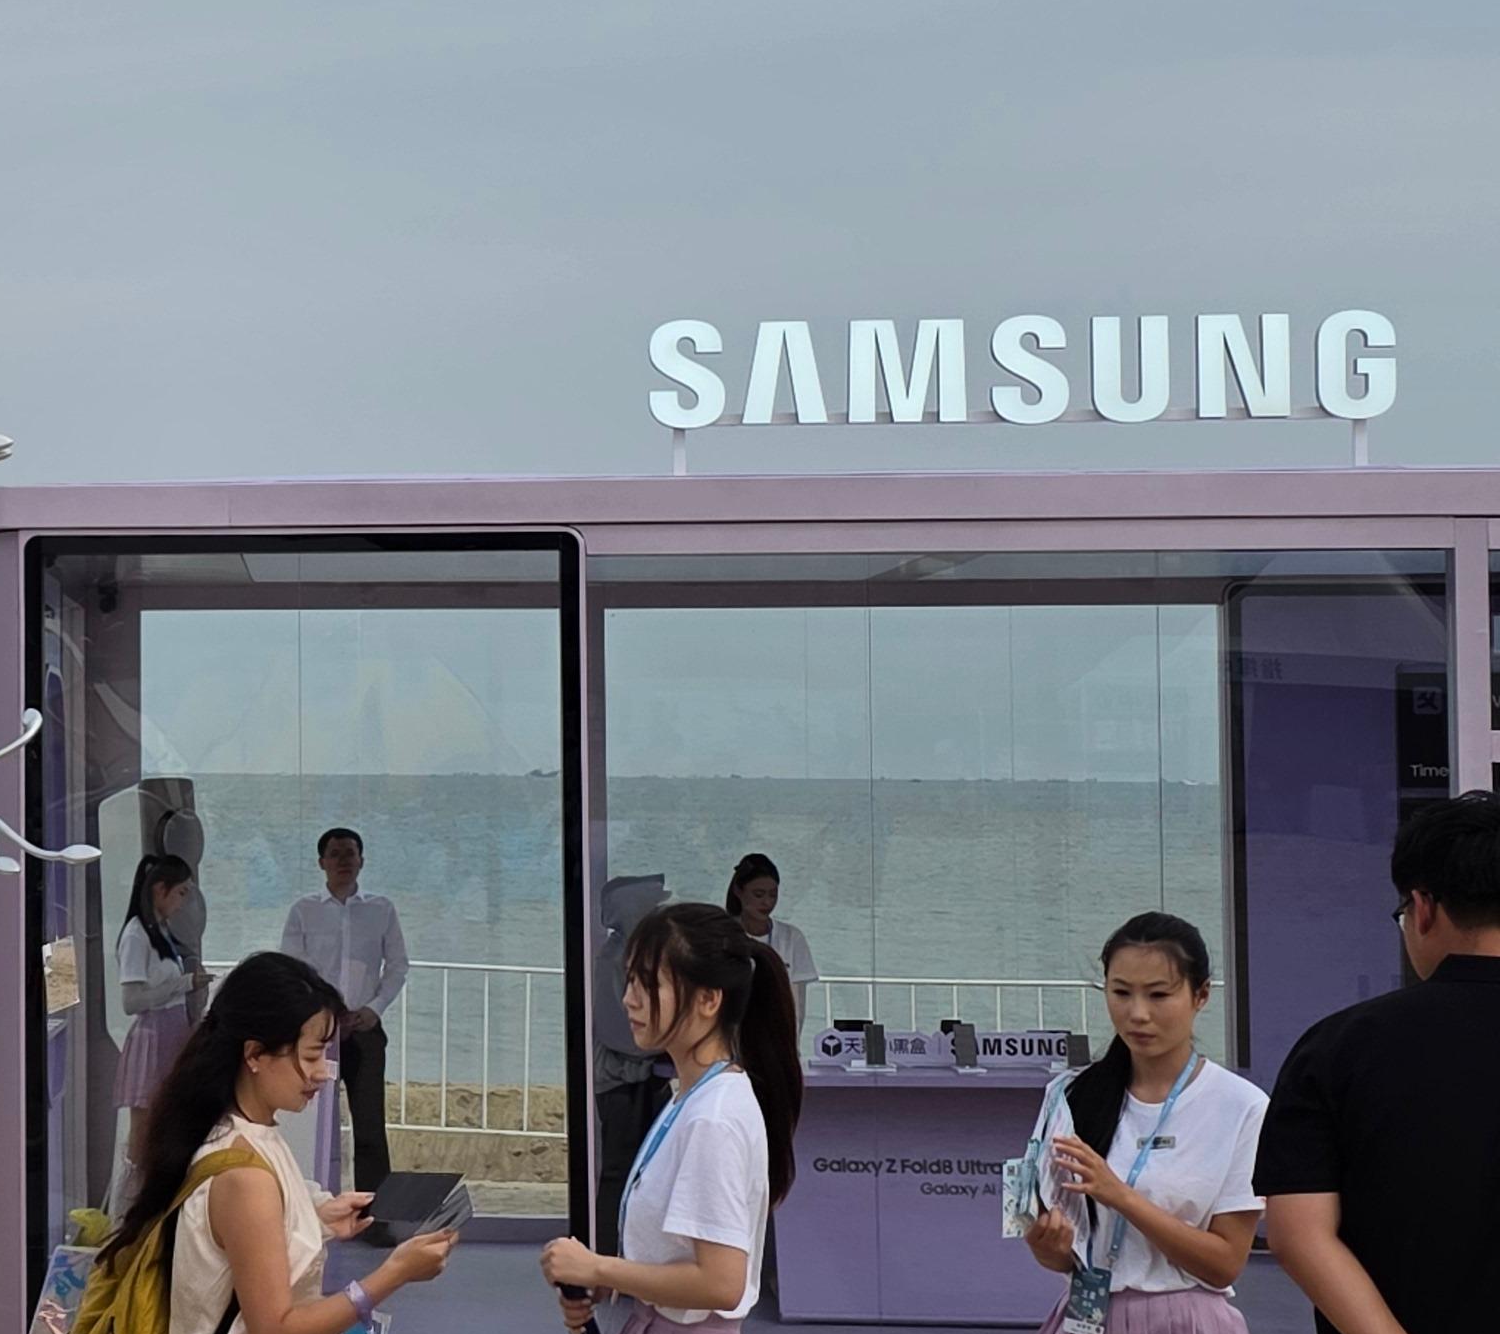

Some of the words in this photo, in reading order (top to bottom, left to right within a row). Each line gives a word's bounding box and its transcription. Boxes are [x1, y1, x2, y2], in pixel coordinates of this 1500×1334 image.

[648, 309, 1397, 429] SAMSUNG
[844, 1037, 927, 1055] 天黑盒
[951, 1038, 1068, 1057] MSUNG
[813, 1157, 882, 1177] Galaxy
[885, 1158, 897, 1174] Z
[901, 1158, 954, 1175] Fold8
[957, 1159, 1003, 1175] Ultra
[920, 1182, 979, 1200] Galaxy
